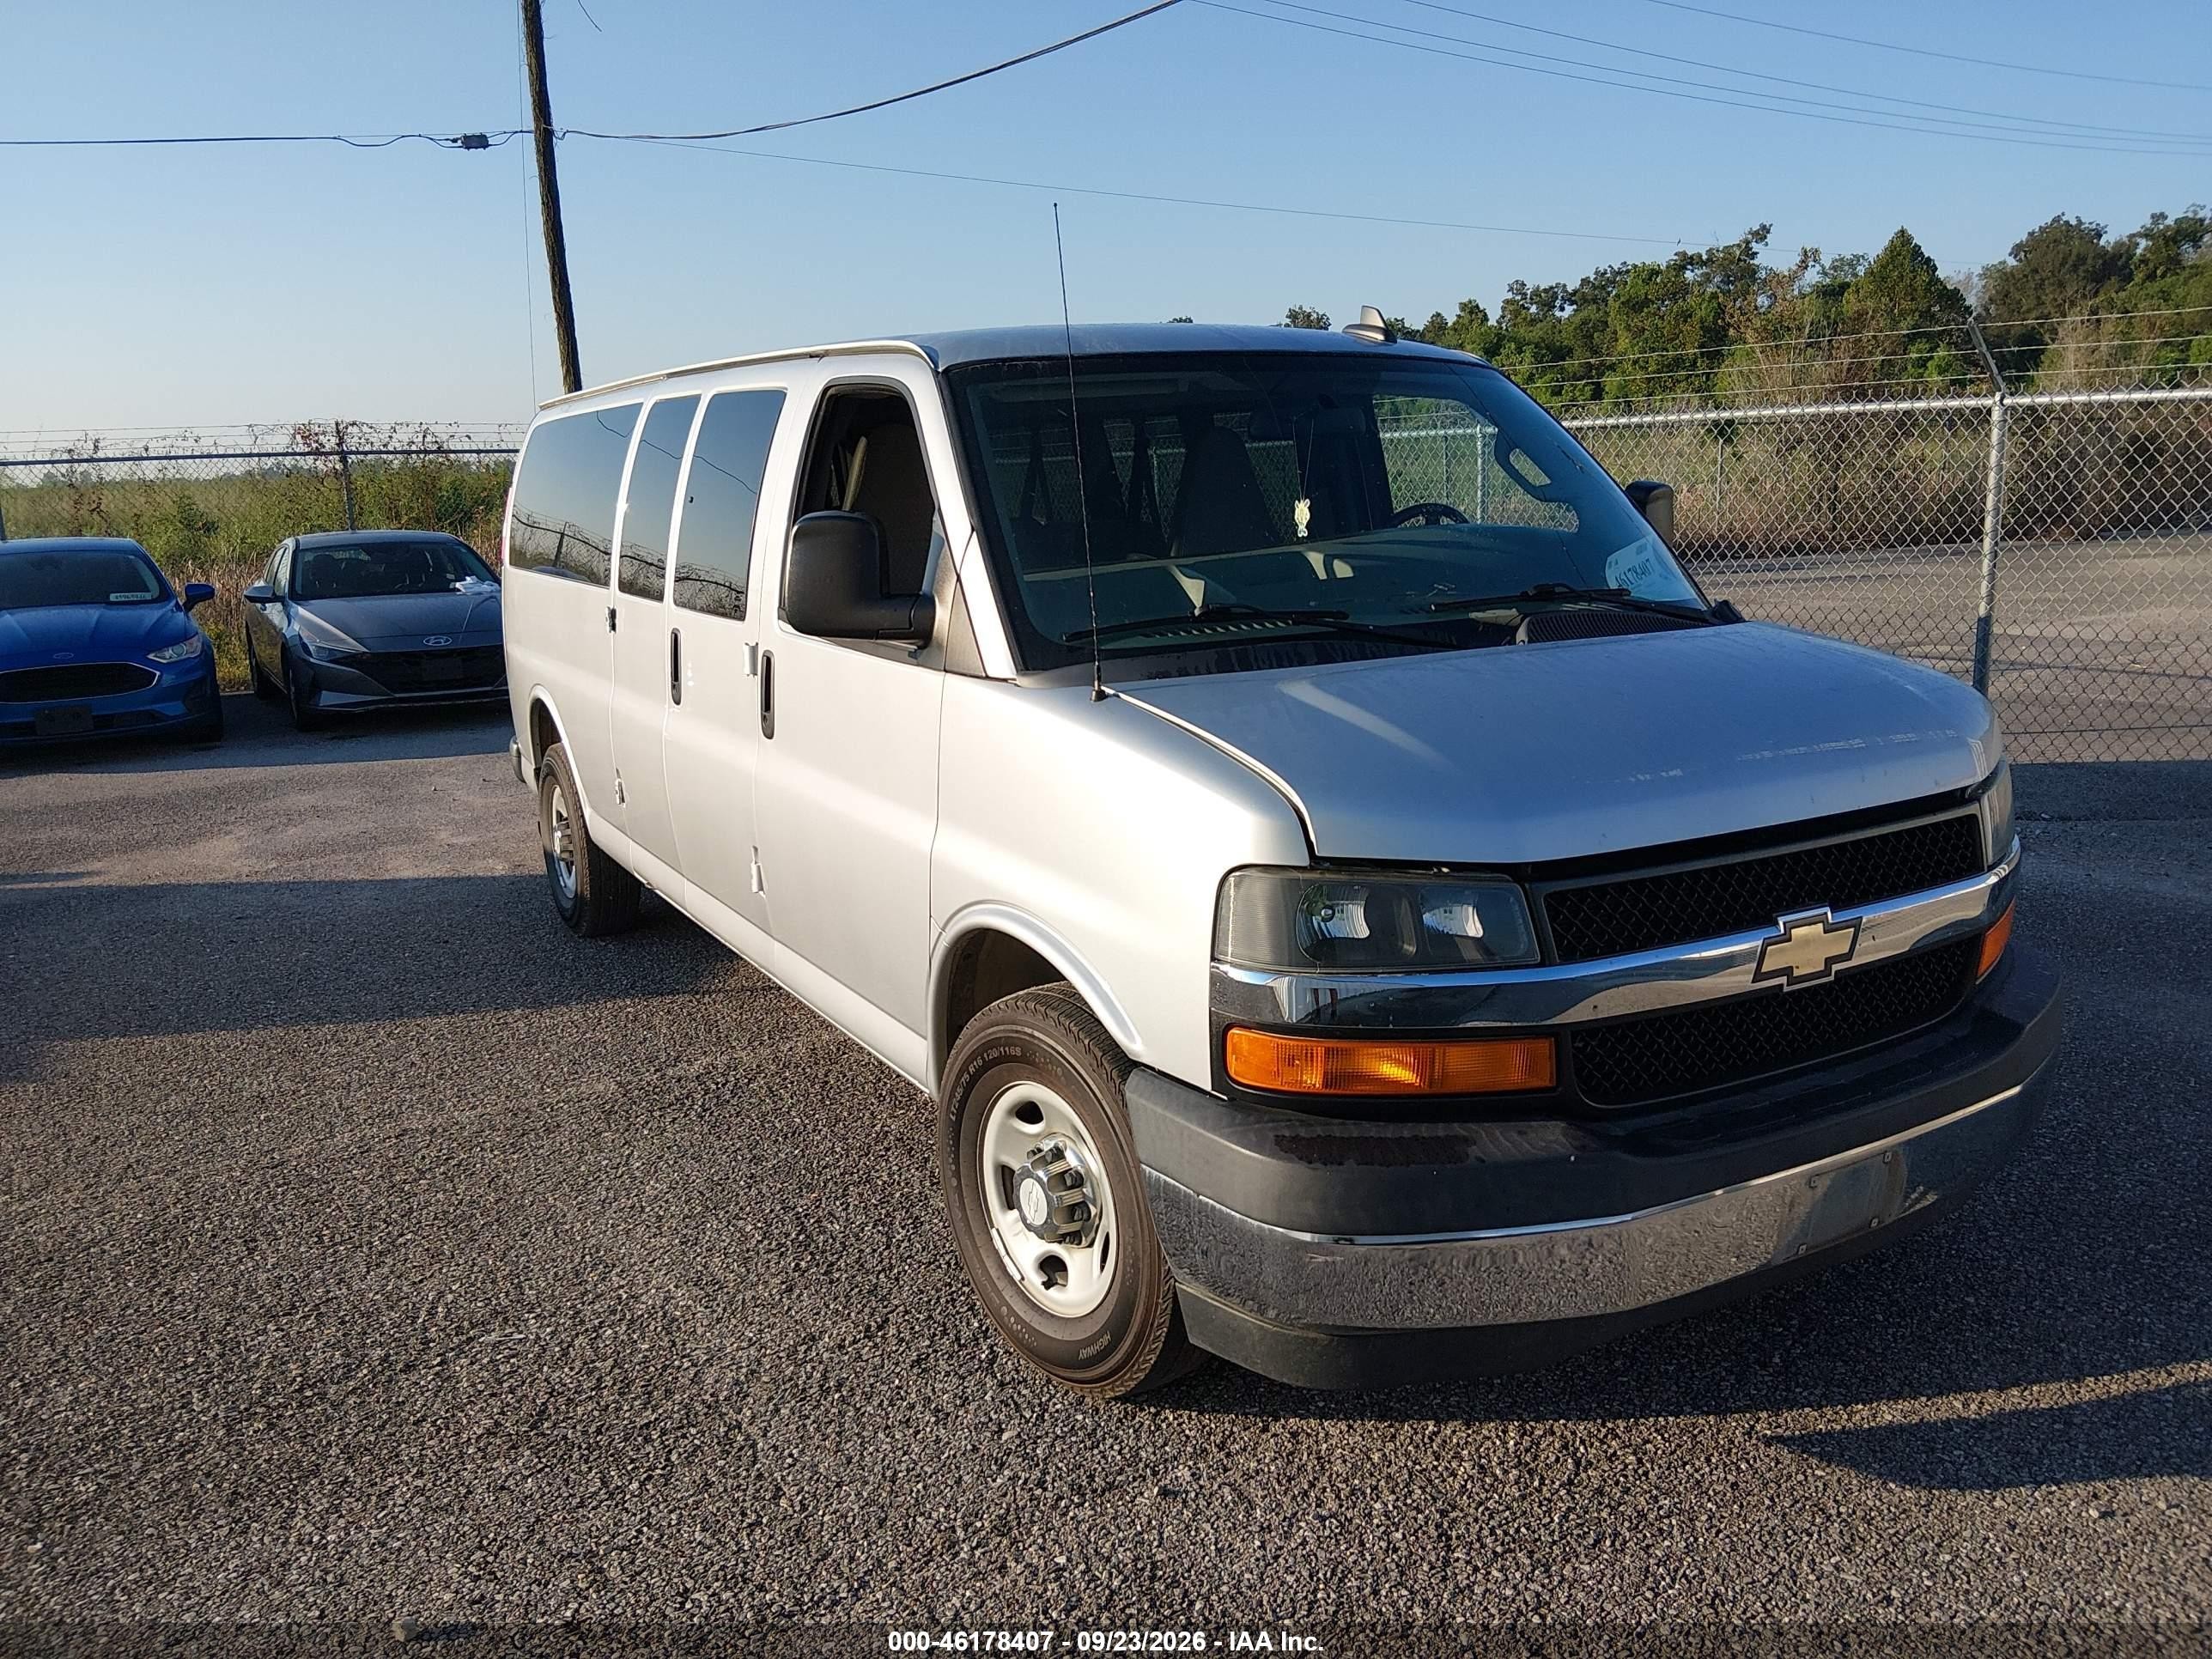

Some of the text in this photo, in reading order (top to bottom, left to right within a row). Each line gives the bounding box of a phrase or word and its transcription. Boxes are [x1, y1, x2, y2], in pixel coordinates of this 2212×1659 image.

[949, 1045, 1023, 1121] LT245/75 R16 120/116S
[1078, 1329, 1112, 1361] HIGHWAY
